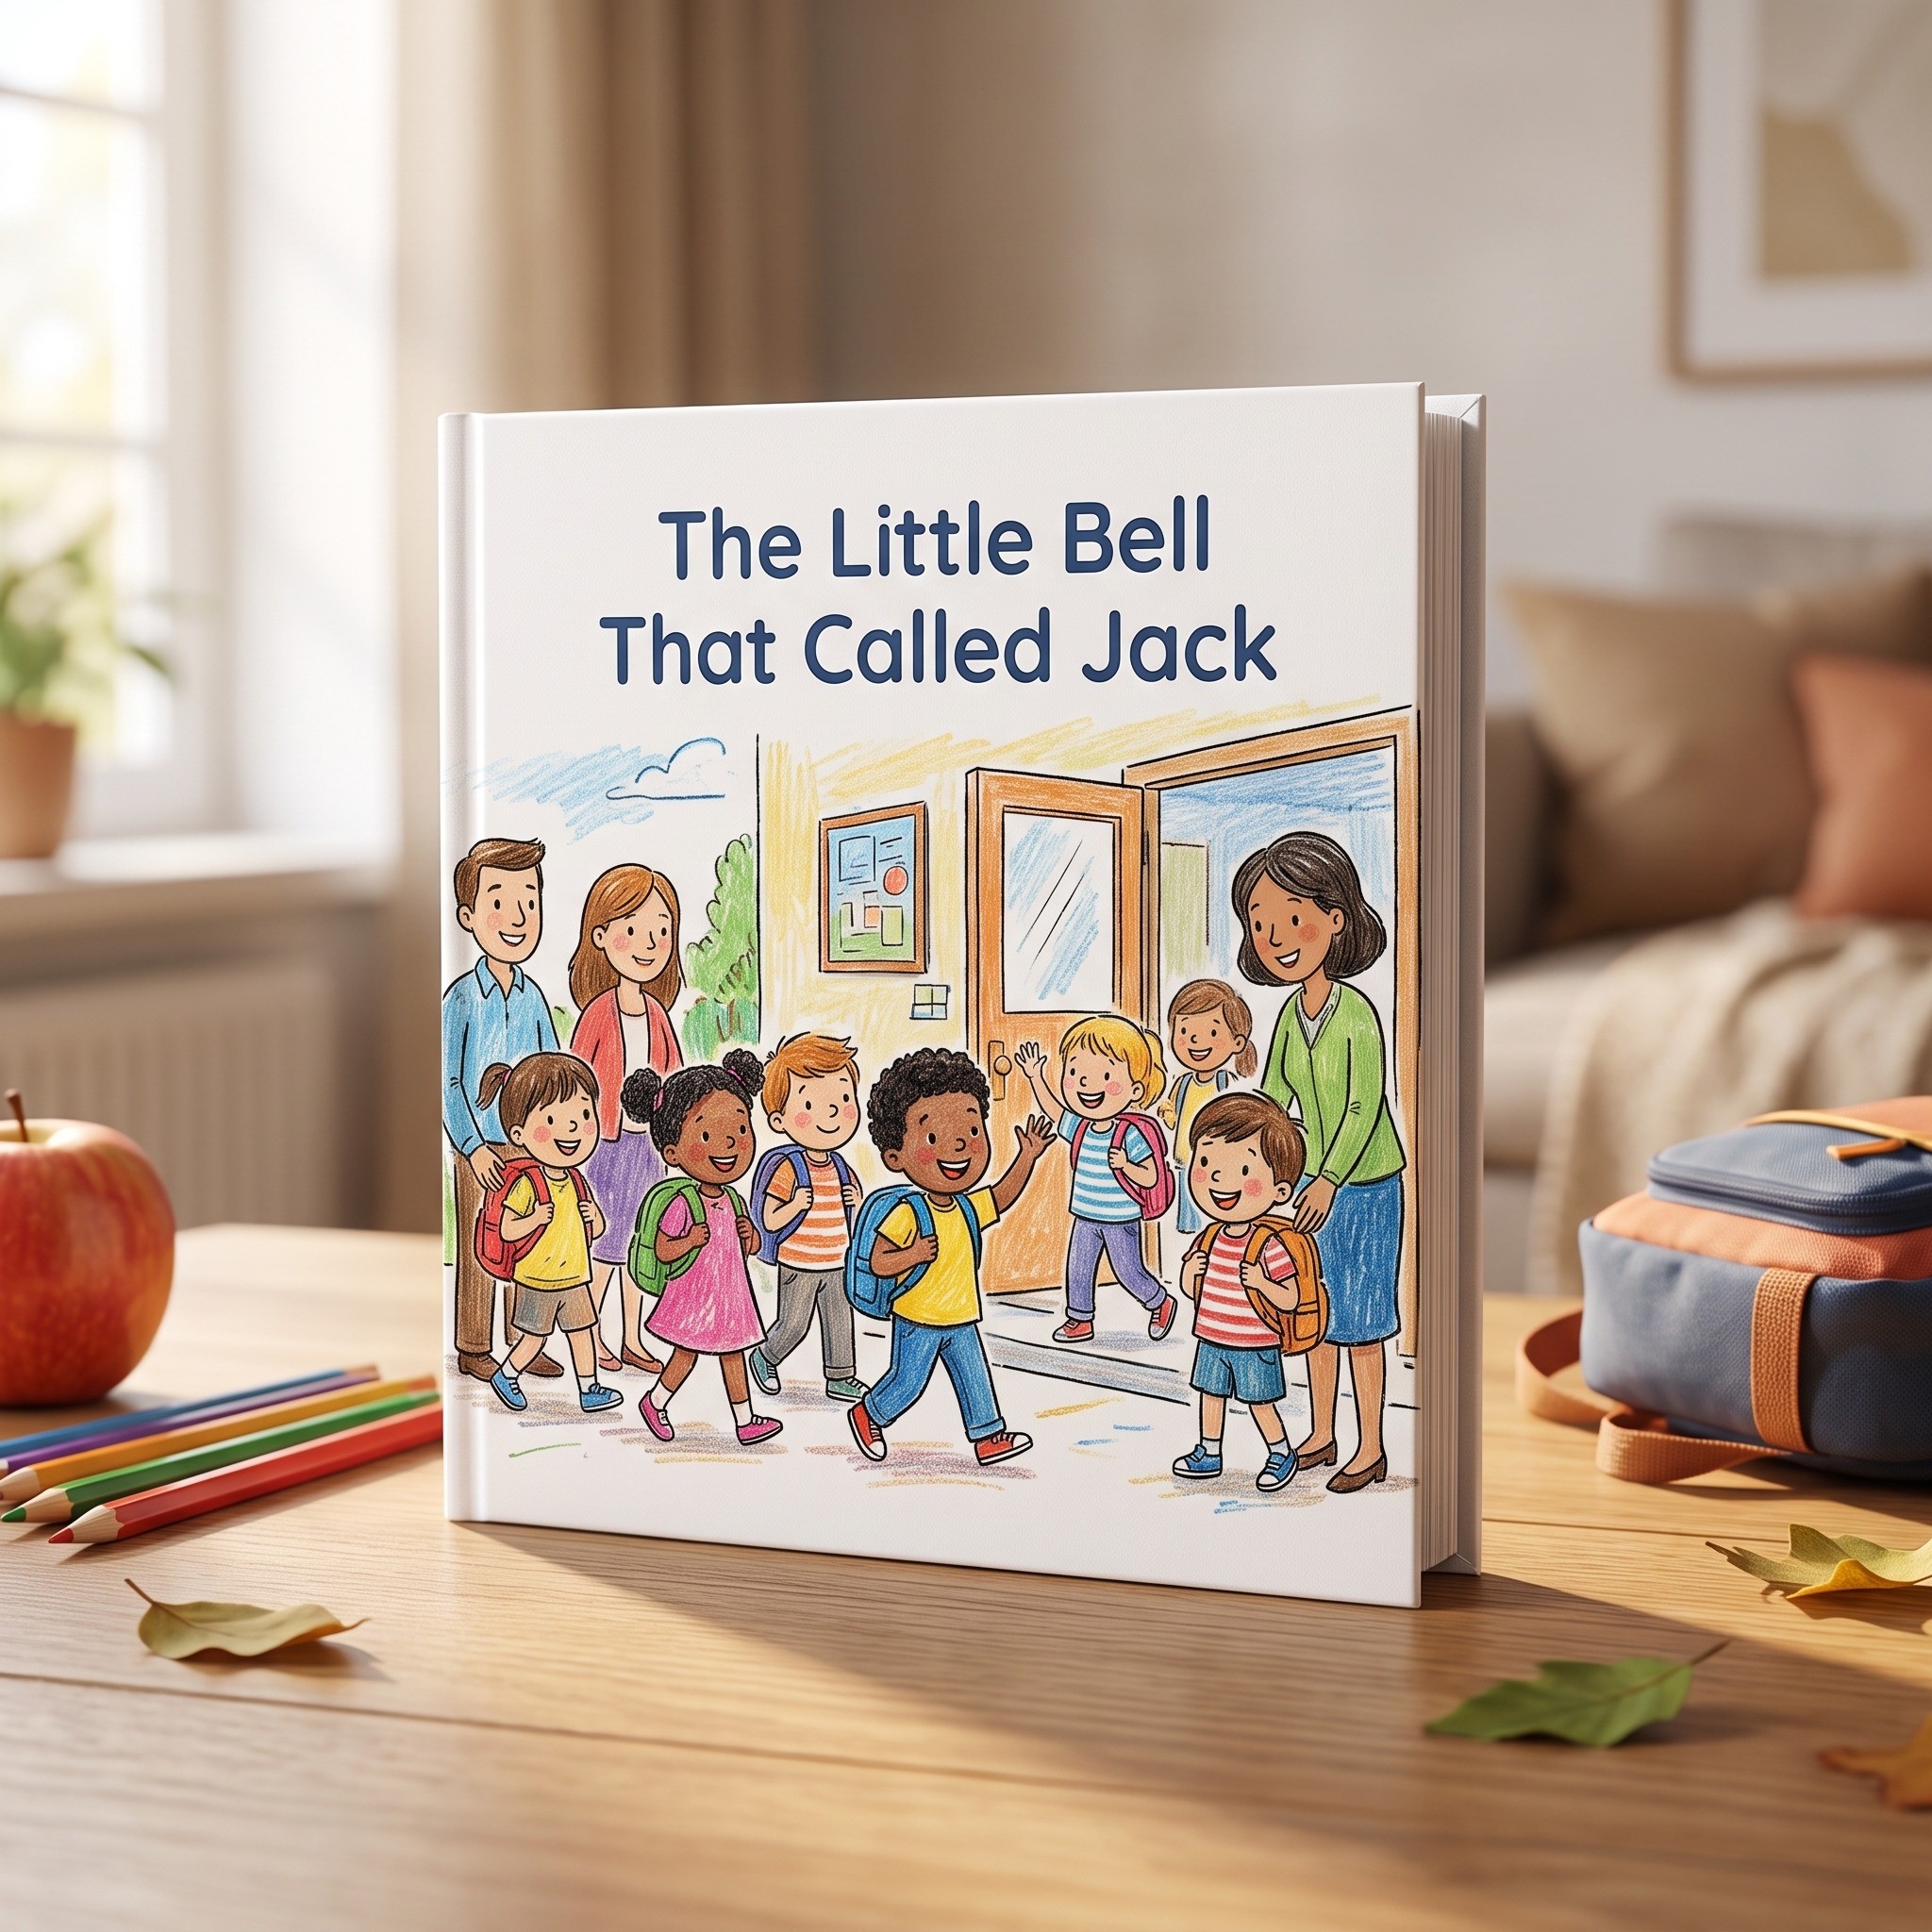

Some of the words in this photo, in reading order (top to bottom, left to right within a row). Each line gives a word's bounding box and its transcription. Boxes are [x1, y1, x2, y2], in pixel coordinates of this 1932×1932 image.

[658, 507, 802, 580] The
[832, 500, 1033, 577] Little
[1064, 494, 1209, 574] Bell
[599, 612, 776, 685] That
[804, 607, 1051, 684] Called
[1081, 604, 1278, 683] Jack
